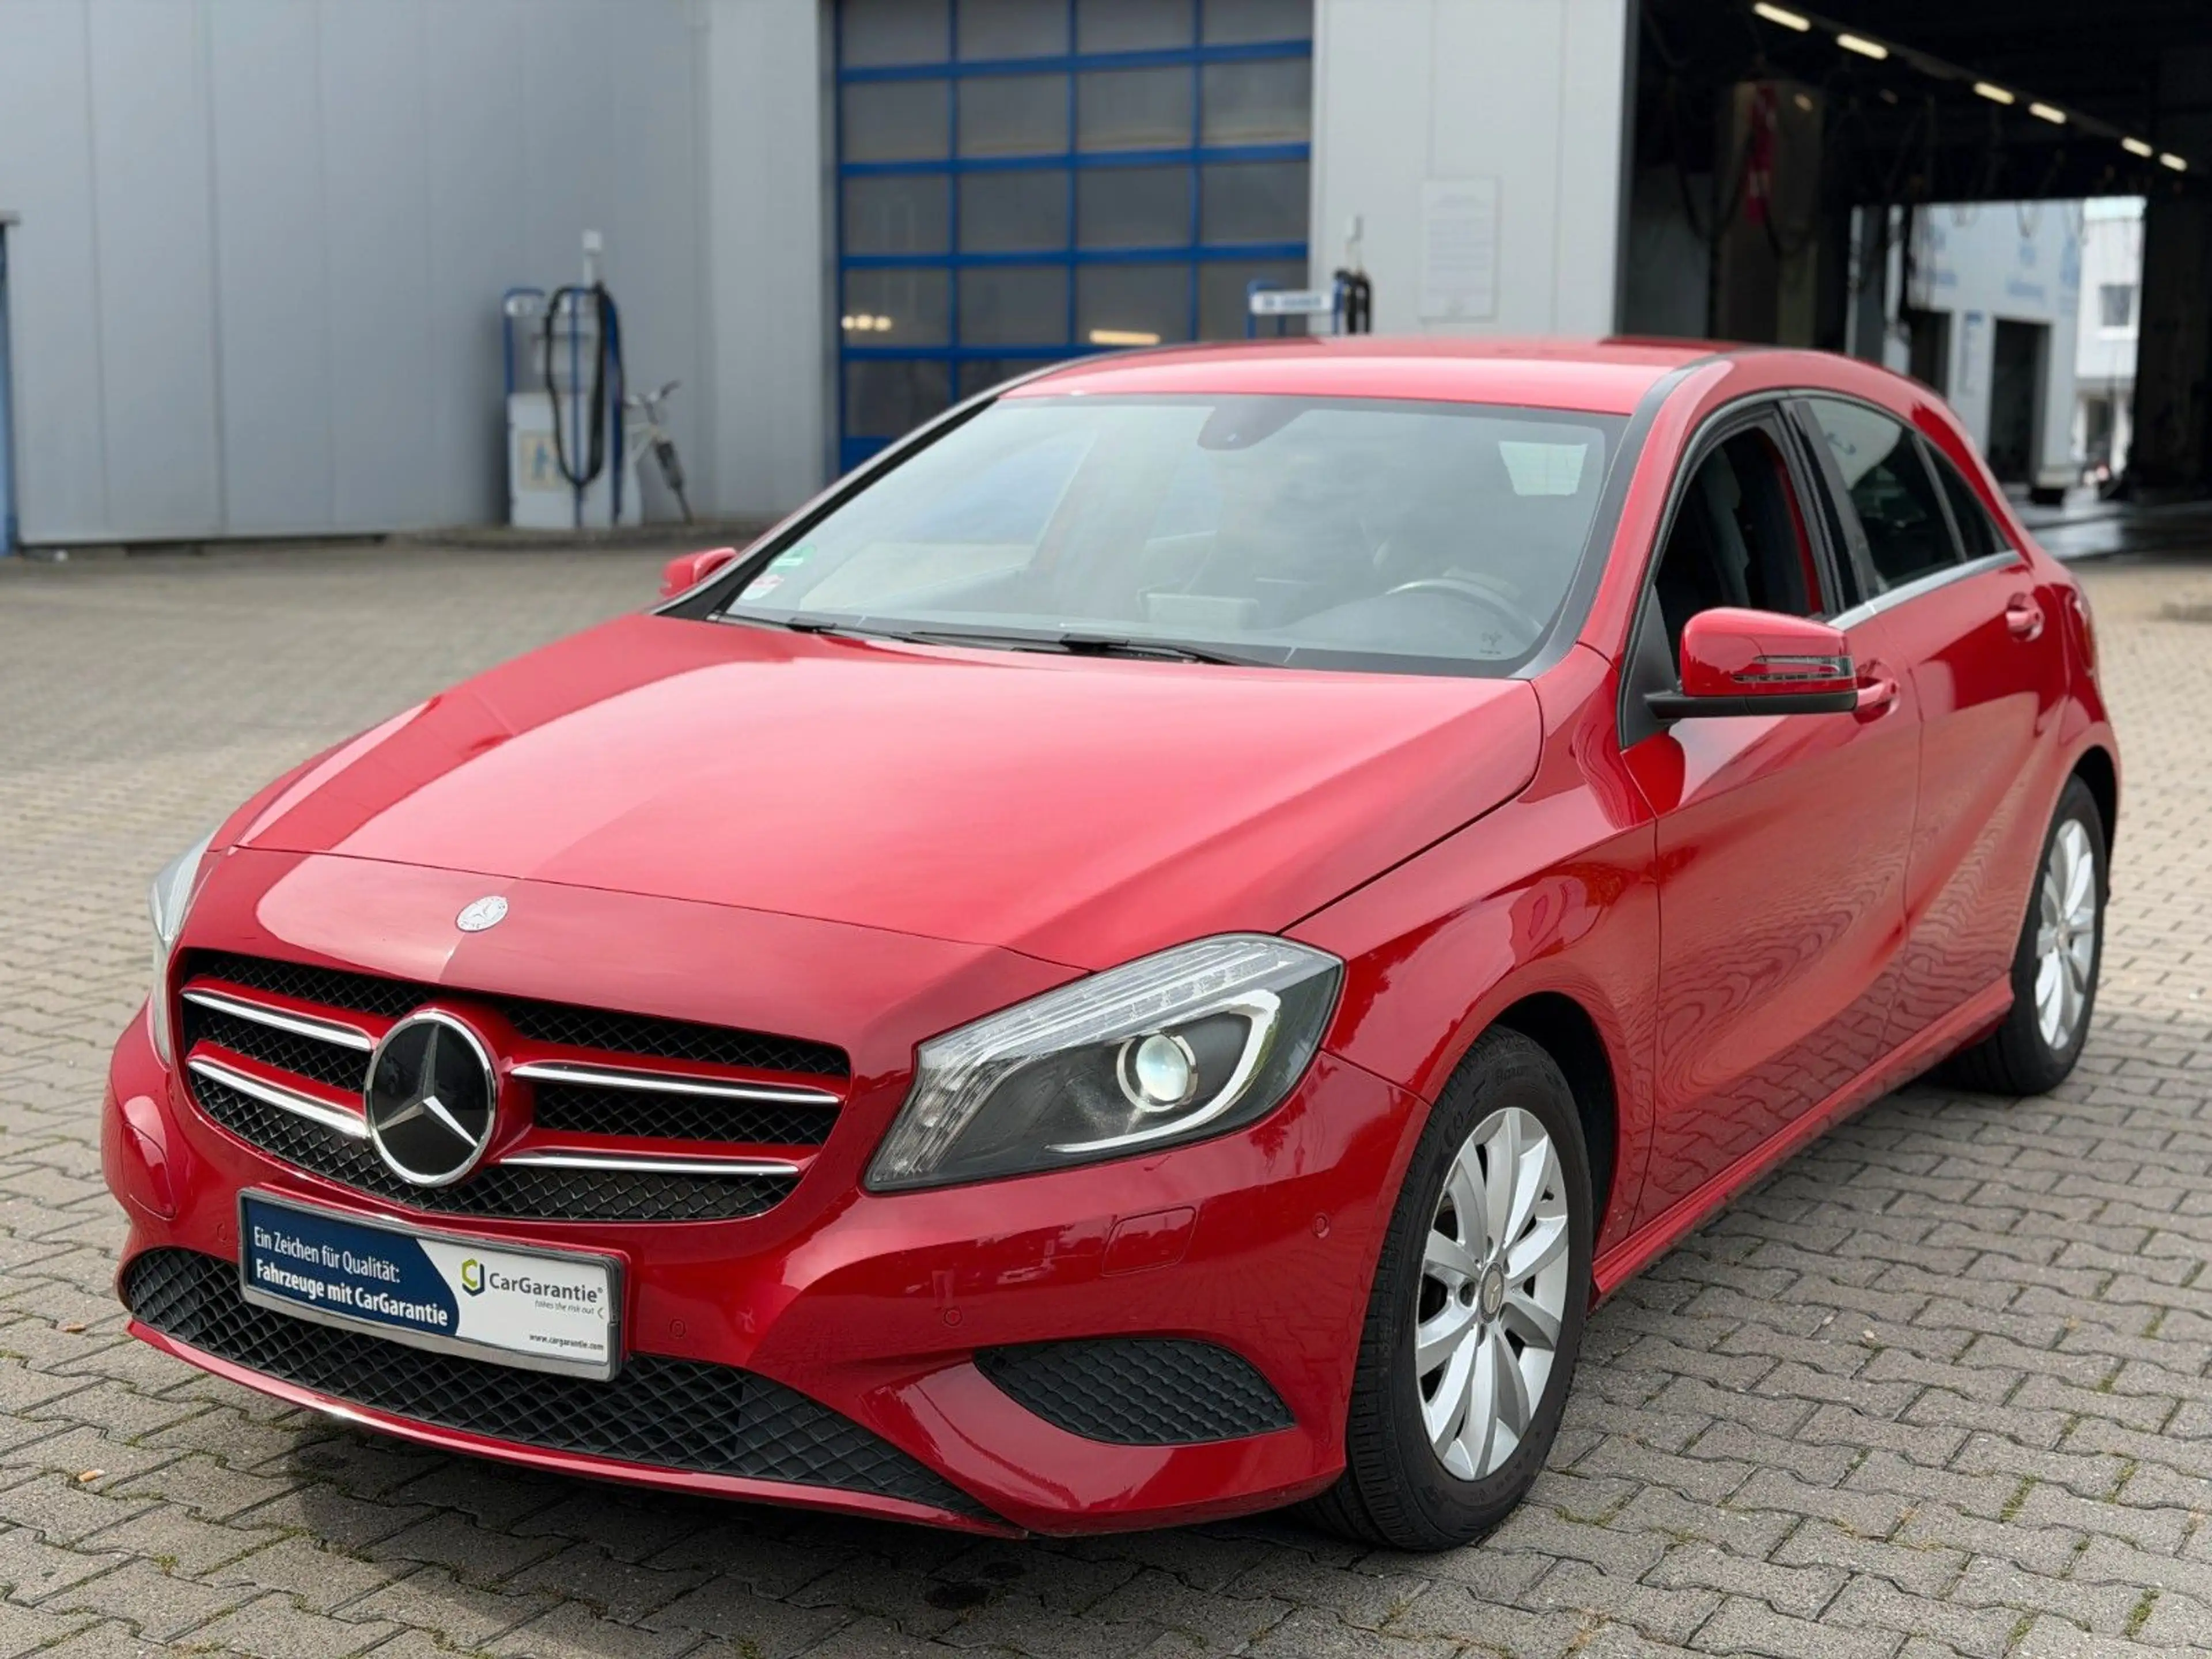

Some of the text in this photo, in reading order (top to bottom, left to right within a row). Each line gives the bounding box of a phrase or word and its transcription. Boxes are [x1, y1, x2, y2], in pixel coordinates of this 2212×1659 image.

[254, 1226, 400, 1283] Ein Zeichen für Qualität:
[256, 1258, 448, 1327] Fahrzeuge mit CarGarantie
[555, 1301, 567, 1312] the
[568, 1304, 580, 1313] risk
[529, 1334, 604, 1350] www.cargarantie.com
